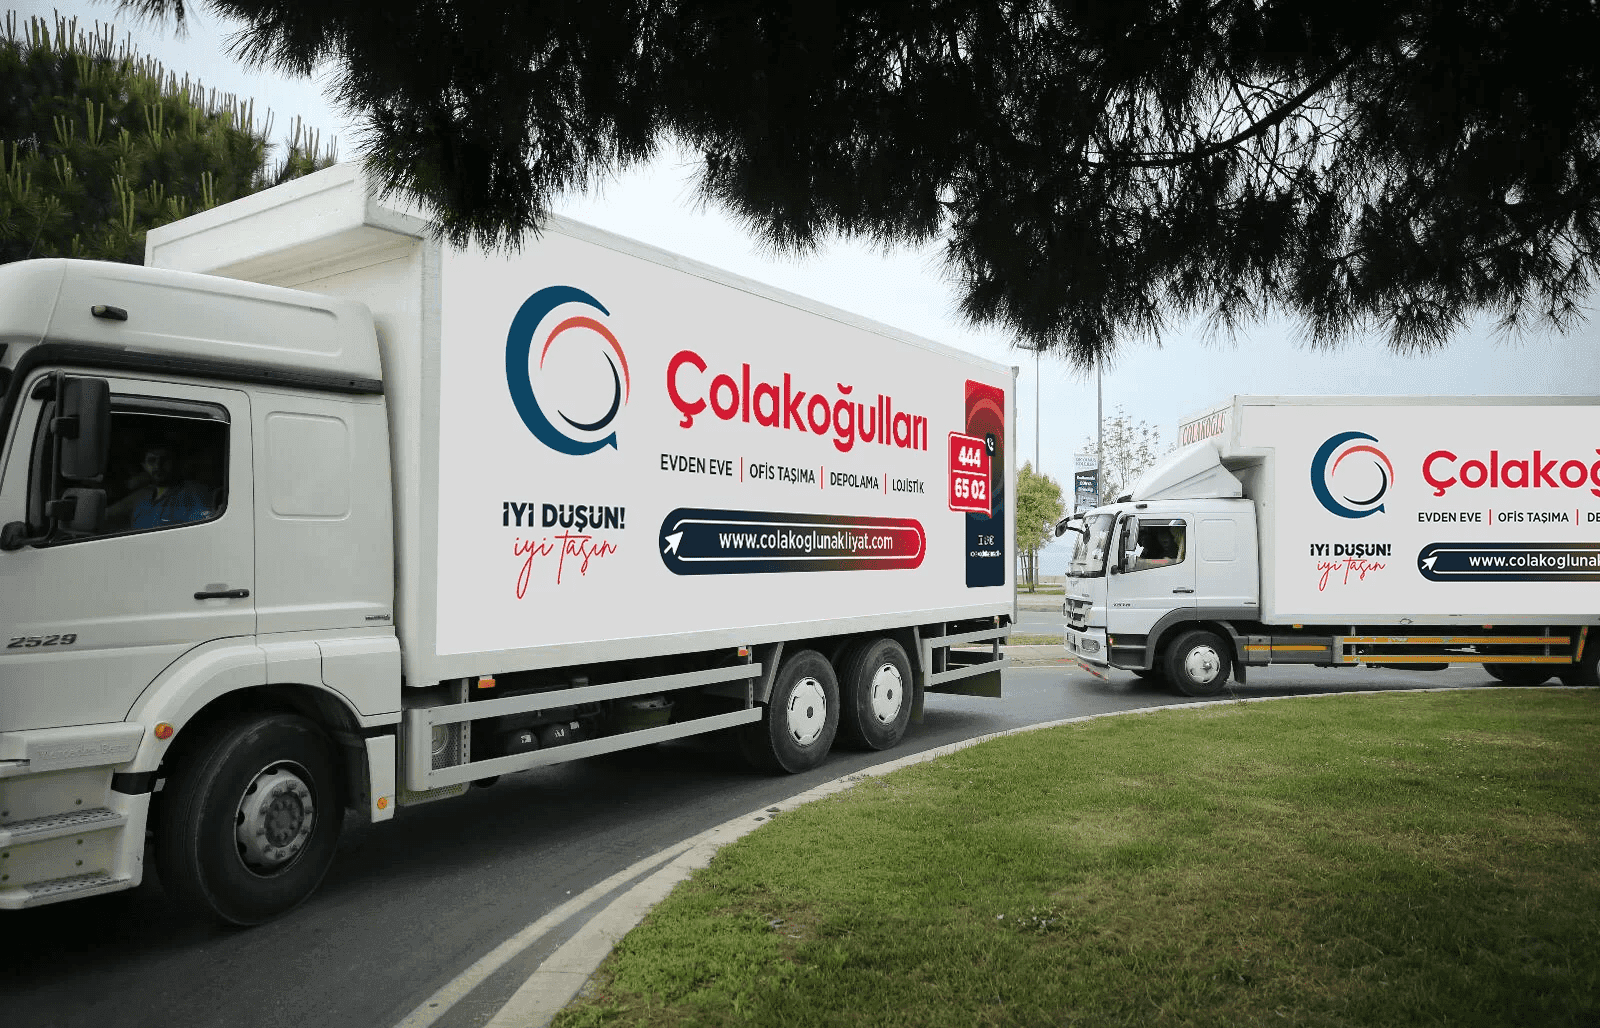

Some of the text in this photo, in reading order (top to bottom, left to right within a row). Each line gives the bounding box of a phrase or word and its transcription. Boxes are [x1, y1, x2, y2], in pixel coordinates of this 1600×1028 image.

[666, 350, 927, 452] Çolakoğulları
[660, 454, 733, 477] EVDEN EVE
[958, 445, 981, 468] 444
[750, 462, 816, 485] OFİS TAŞIMA
[830, 471, 879, 490] DEPOLAMA
[892, 478, 925, 495] LOJİSTİK
[954, 477, 986, 500] 65 02
[1418, 512, 1482, 523] EVDEN EVE
[1498, 510, 1570, 524] OFİS TAŞIMA
[718, 529, 894, 552] www.colakoglunakliyat.com
[514, 537, 554, 600] iyi
[1317, 560, 1343, 592] iyi
[6, 633, 78, 648] 2529
